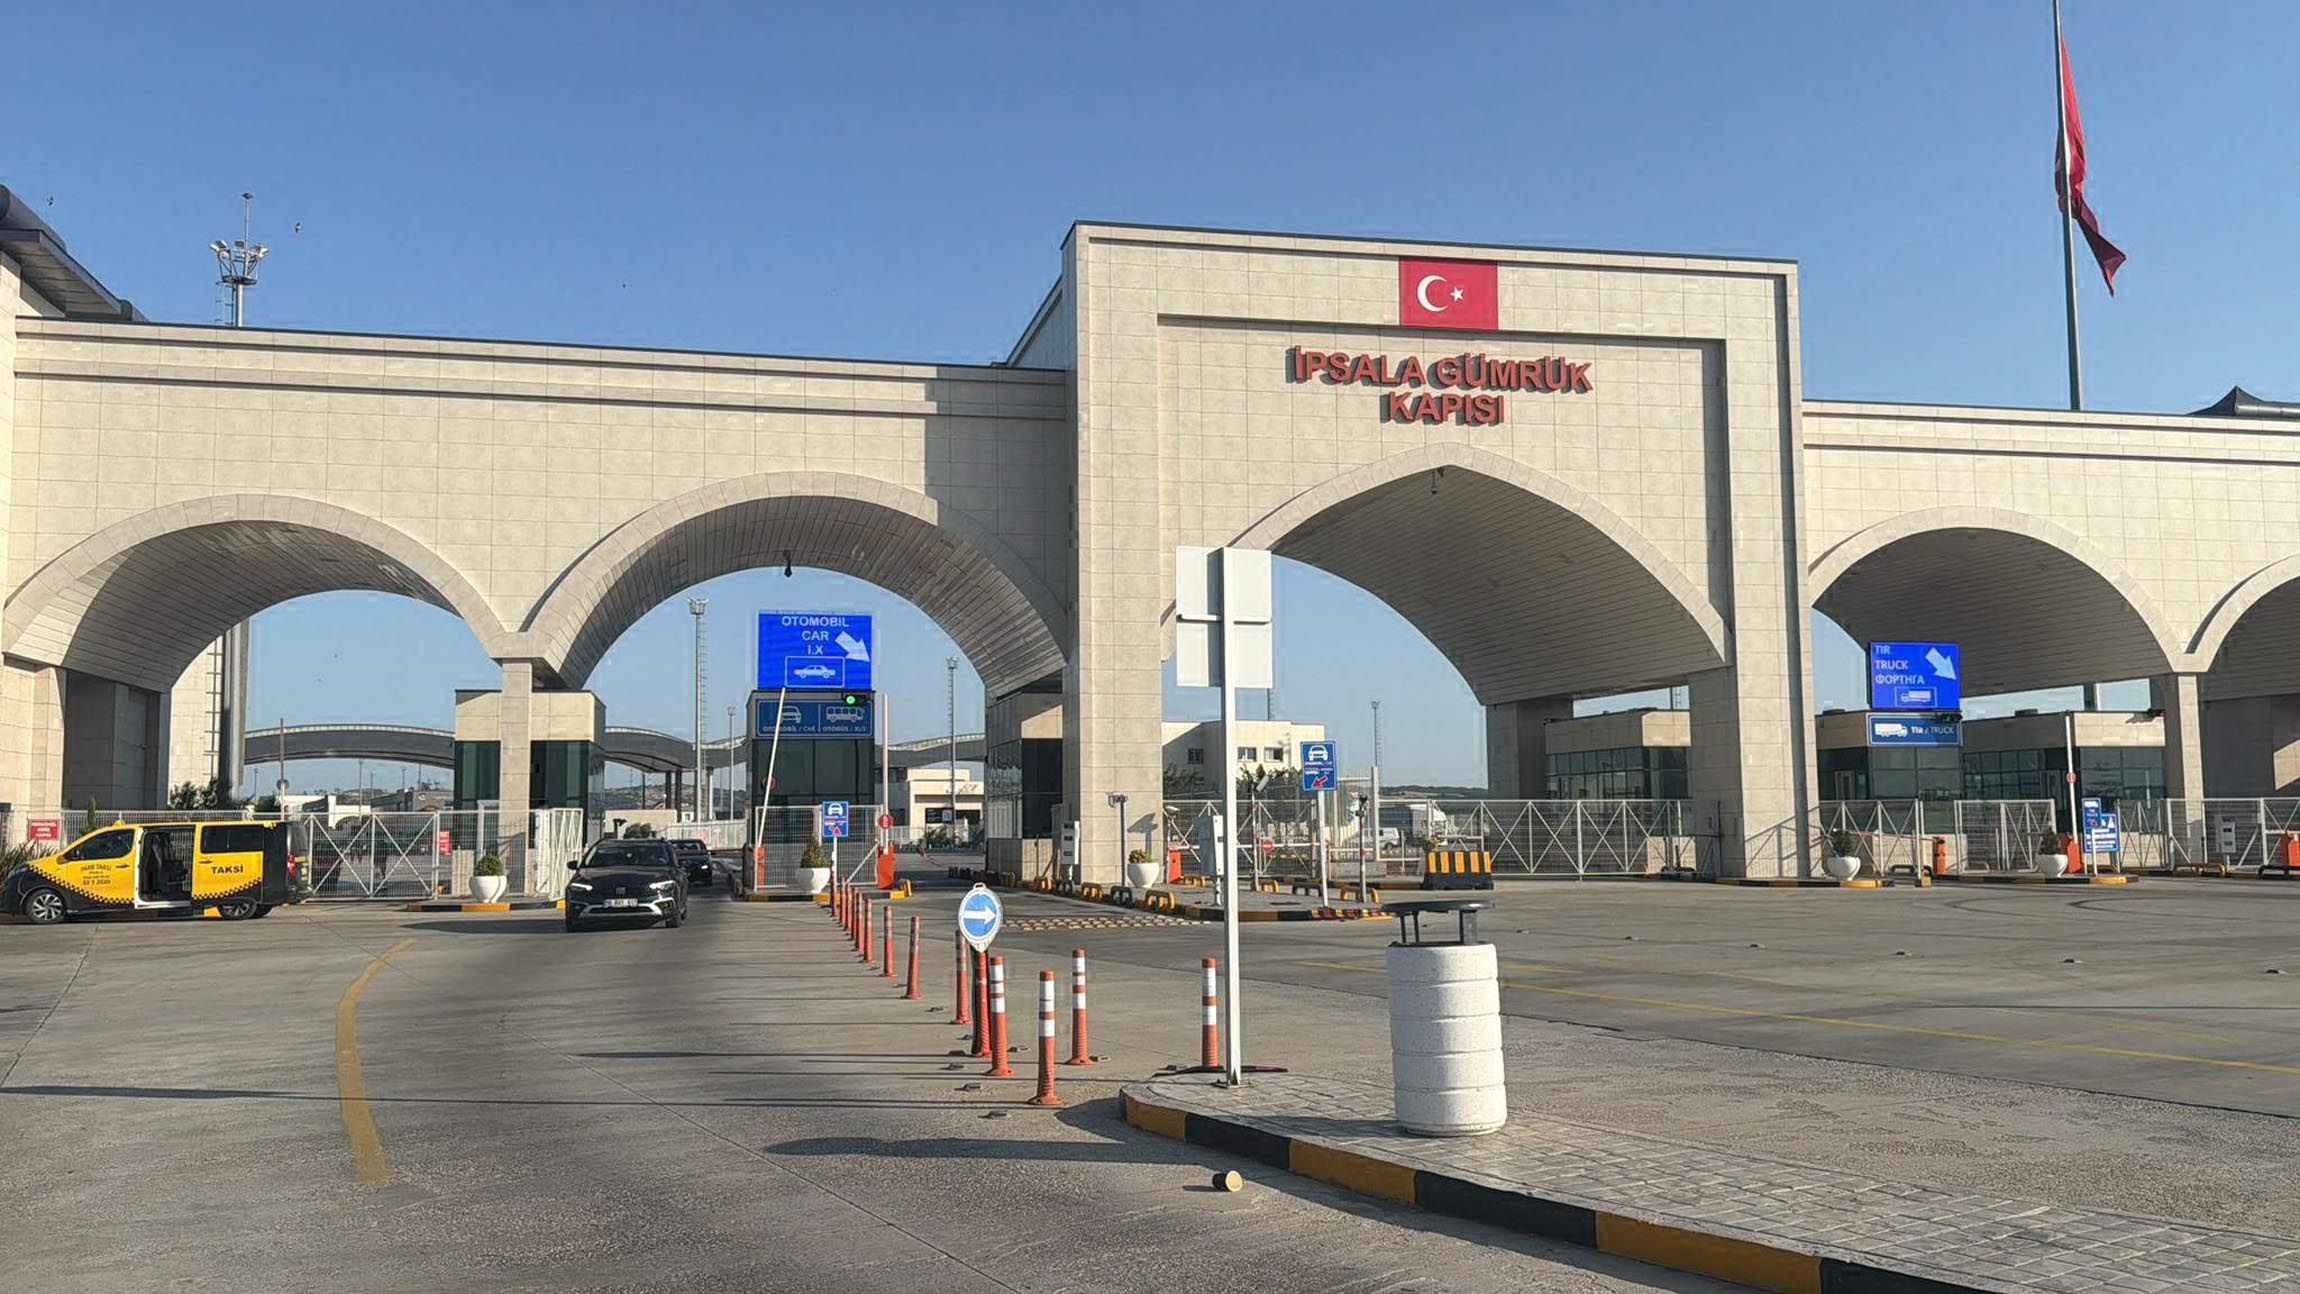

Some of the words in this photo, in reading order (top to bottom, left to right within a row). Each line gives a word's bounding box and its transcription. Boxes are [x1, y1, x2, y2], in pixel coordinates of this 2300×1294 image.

[1294, 344, 1427, 386] İPSALA
[1435, 351, 1594, 392] GÜMRÜK
[1388, 391, 1505, 425] KAPISI
[801, 630, 829, 641] CAR
[1875, 645, 1891, 655] TIR
[1875, 660, 1909, 670] TRUCK
[1931, 726, 1955, 735] TRUCK
[211, 864, 244, 874] TAKSİ
